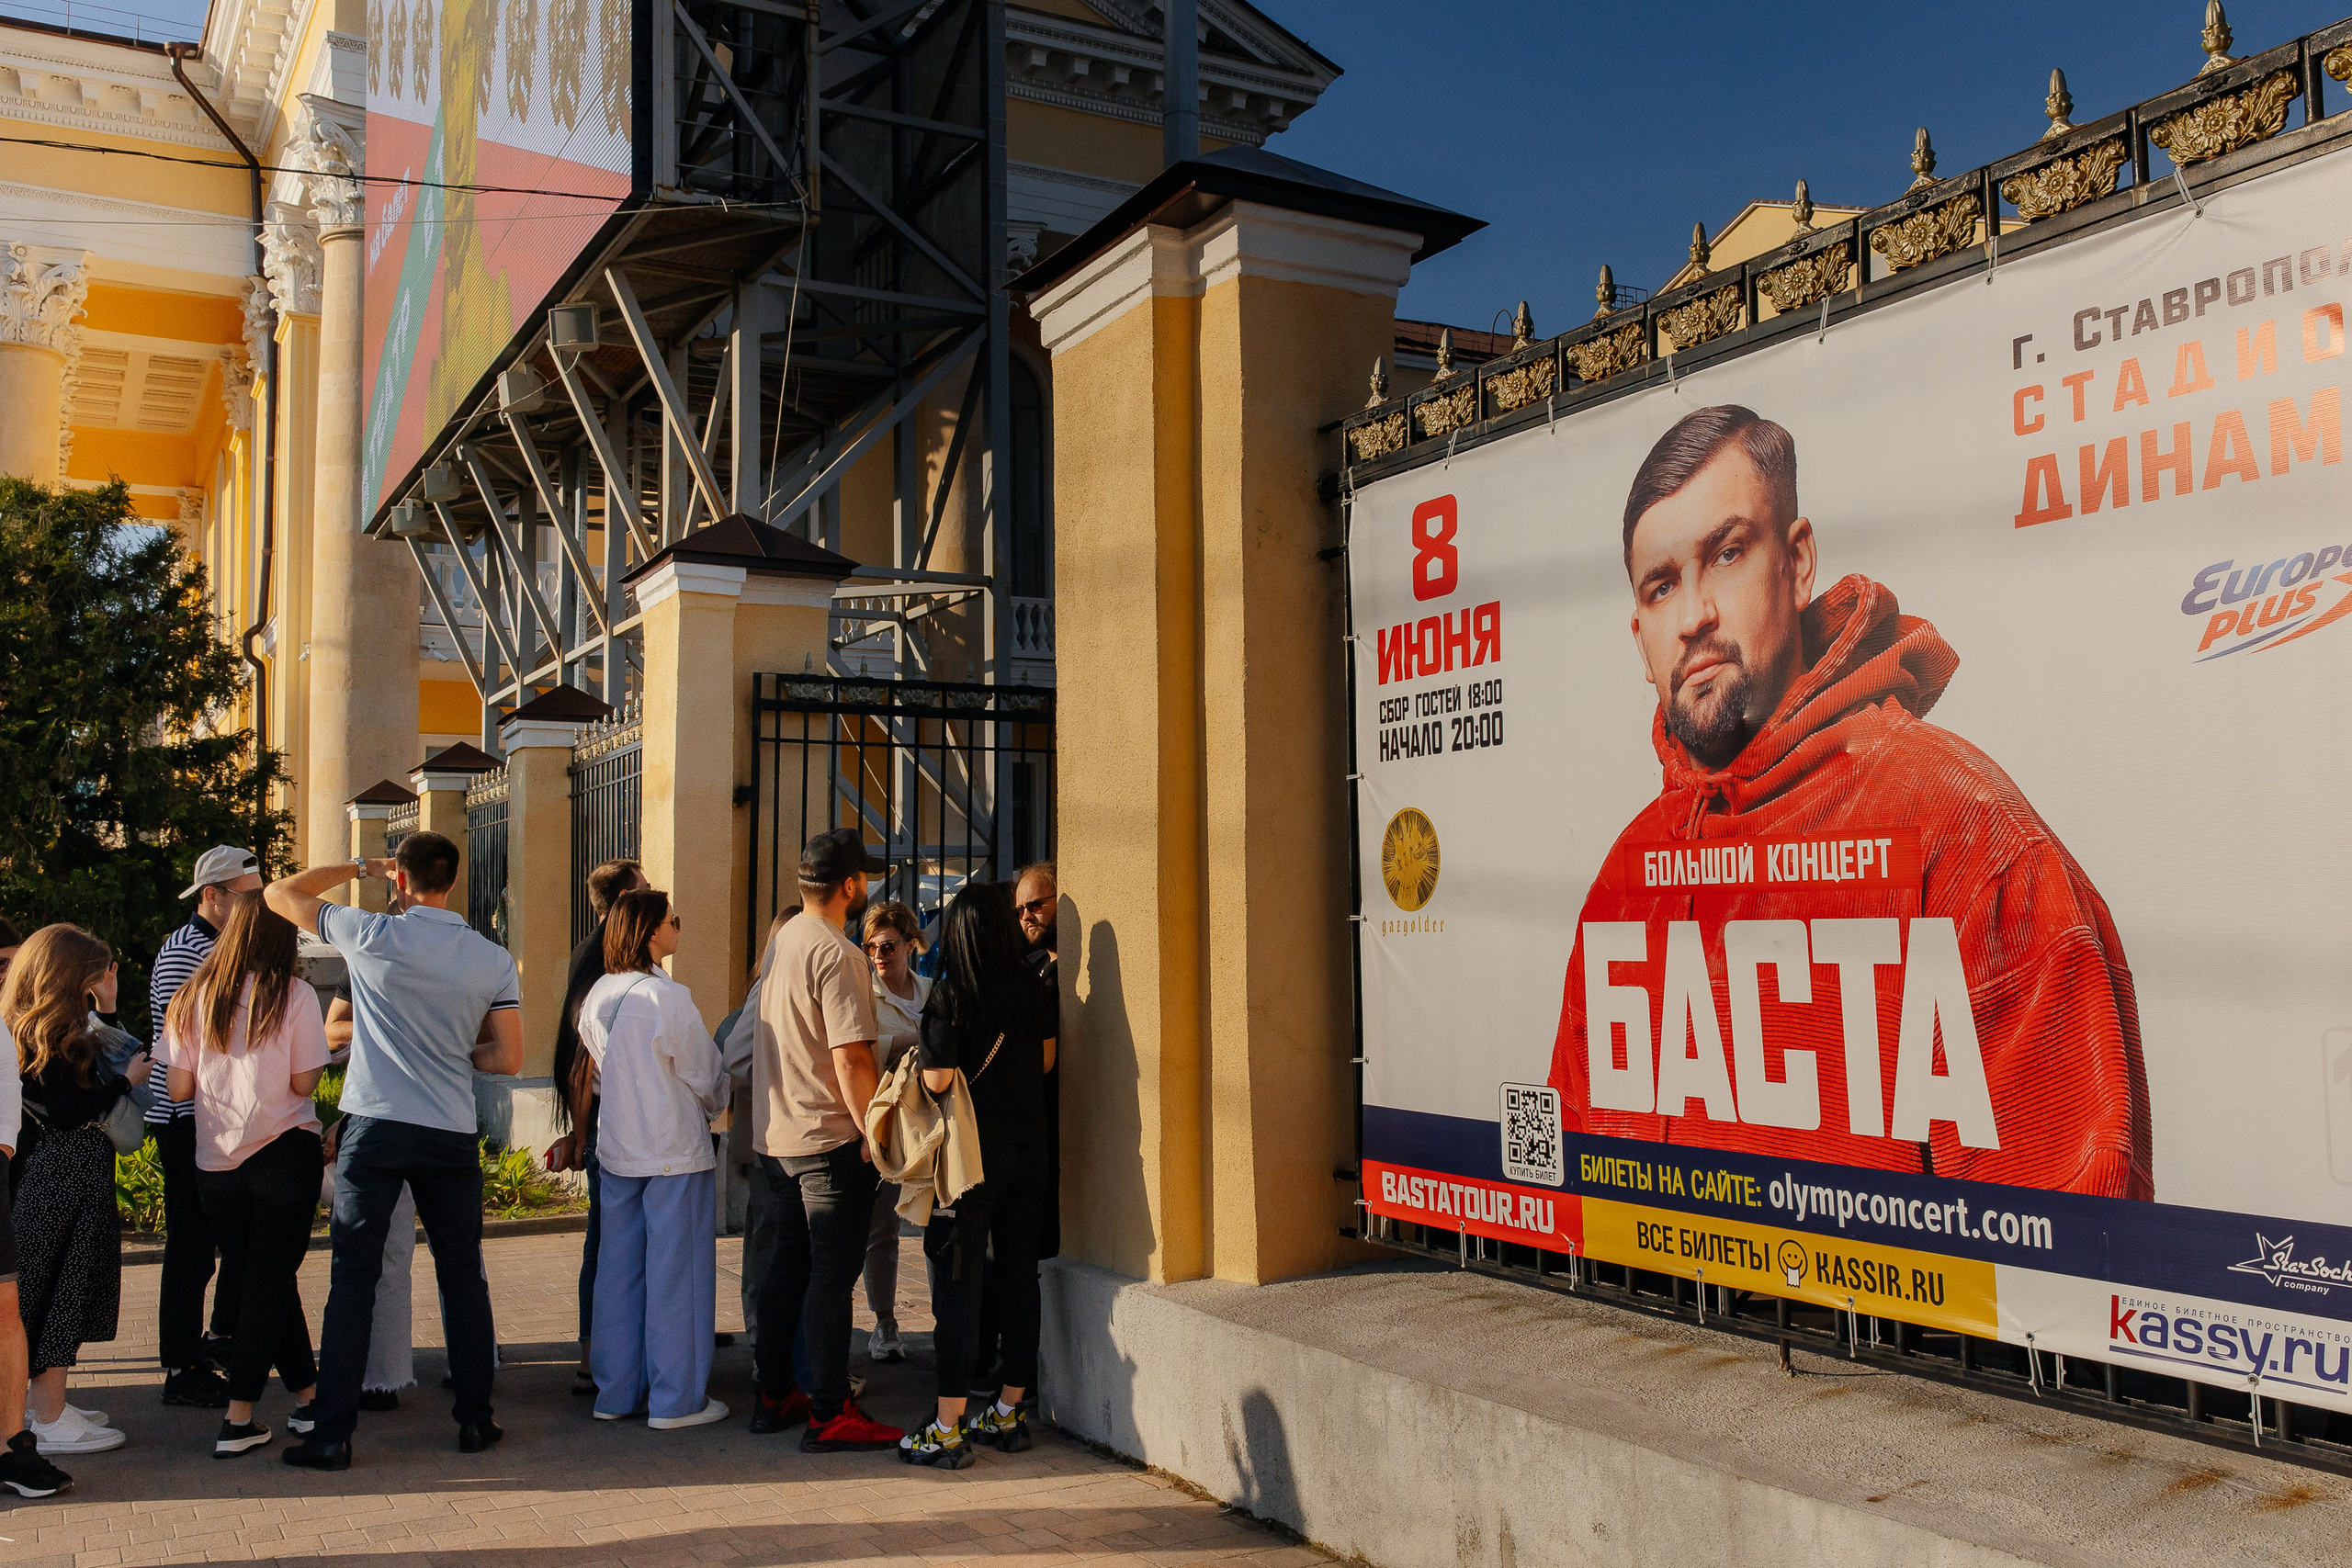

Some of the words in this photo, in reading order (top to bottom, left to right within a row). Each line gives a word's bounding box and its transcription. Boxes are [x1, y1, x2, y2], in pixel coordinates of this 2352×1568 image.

[369, 288, 411, 479] ТЕАТР
[1412, 494, 1458, 601] 8
[1377, 600, 1501, 685] ИЮНЯ
[1379, 695, 1409, 725] СБОР
[1415, 684, 1461, 717] ГОСТЕЙ
[1467, 678, 1503, 709] 18:00
[1379, 719, 1442, 762] НАЧАЛО
[1451, 710, 1503, 753] 20:00
[1644, 841, 1755, 887] БОЛЬШОЙ
[1767, 838, 1892, 883] КОНЦЕРТ
[1382, 916, 1444, 936] gazgolder
[1582, 917, 2000, 1151] БАСТА
[1381, 1170, 1555, 1235] BASTATOUR.RU
[1510, 1167, 1533, 1178] КУПИТЬ
[1535, 1170, 1556, 1181] БИЛЕТ
[1580, 1154, 1653, 1191] БИЛЕТЫ
[1658, 1164, 1686, 1196] НА
[1690, 1169, 1762, 1208] САЙТЕ:
[1769, 1172, 2052, 1249] olympconcert.com
[1636, 1221, 1674, 1254] ВСЕ
[1679, 1228, 1770, 1273] БИЛЕТЫ
[1815, 1251, 1945, 1306] KASSIR.RU
[2284, 1280, 2330, 1295] company
[2109, 1294, 2350, 1384] kassy.ru
[2121, 1296, 2166, 1312] ЕДИНОЕ
[2176, 1306, 2237, 1324] БИЛЕТНОЕ
[2247, 1318, 2350, 1344] ПРОСТРАНСТВО
